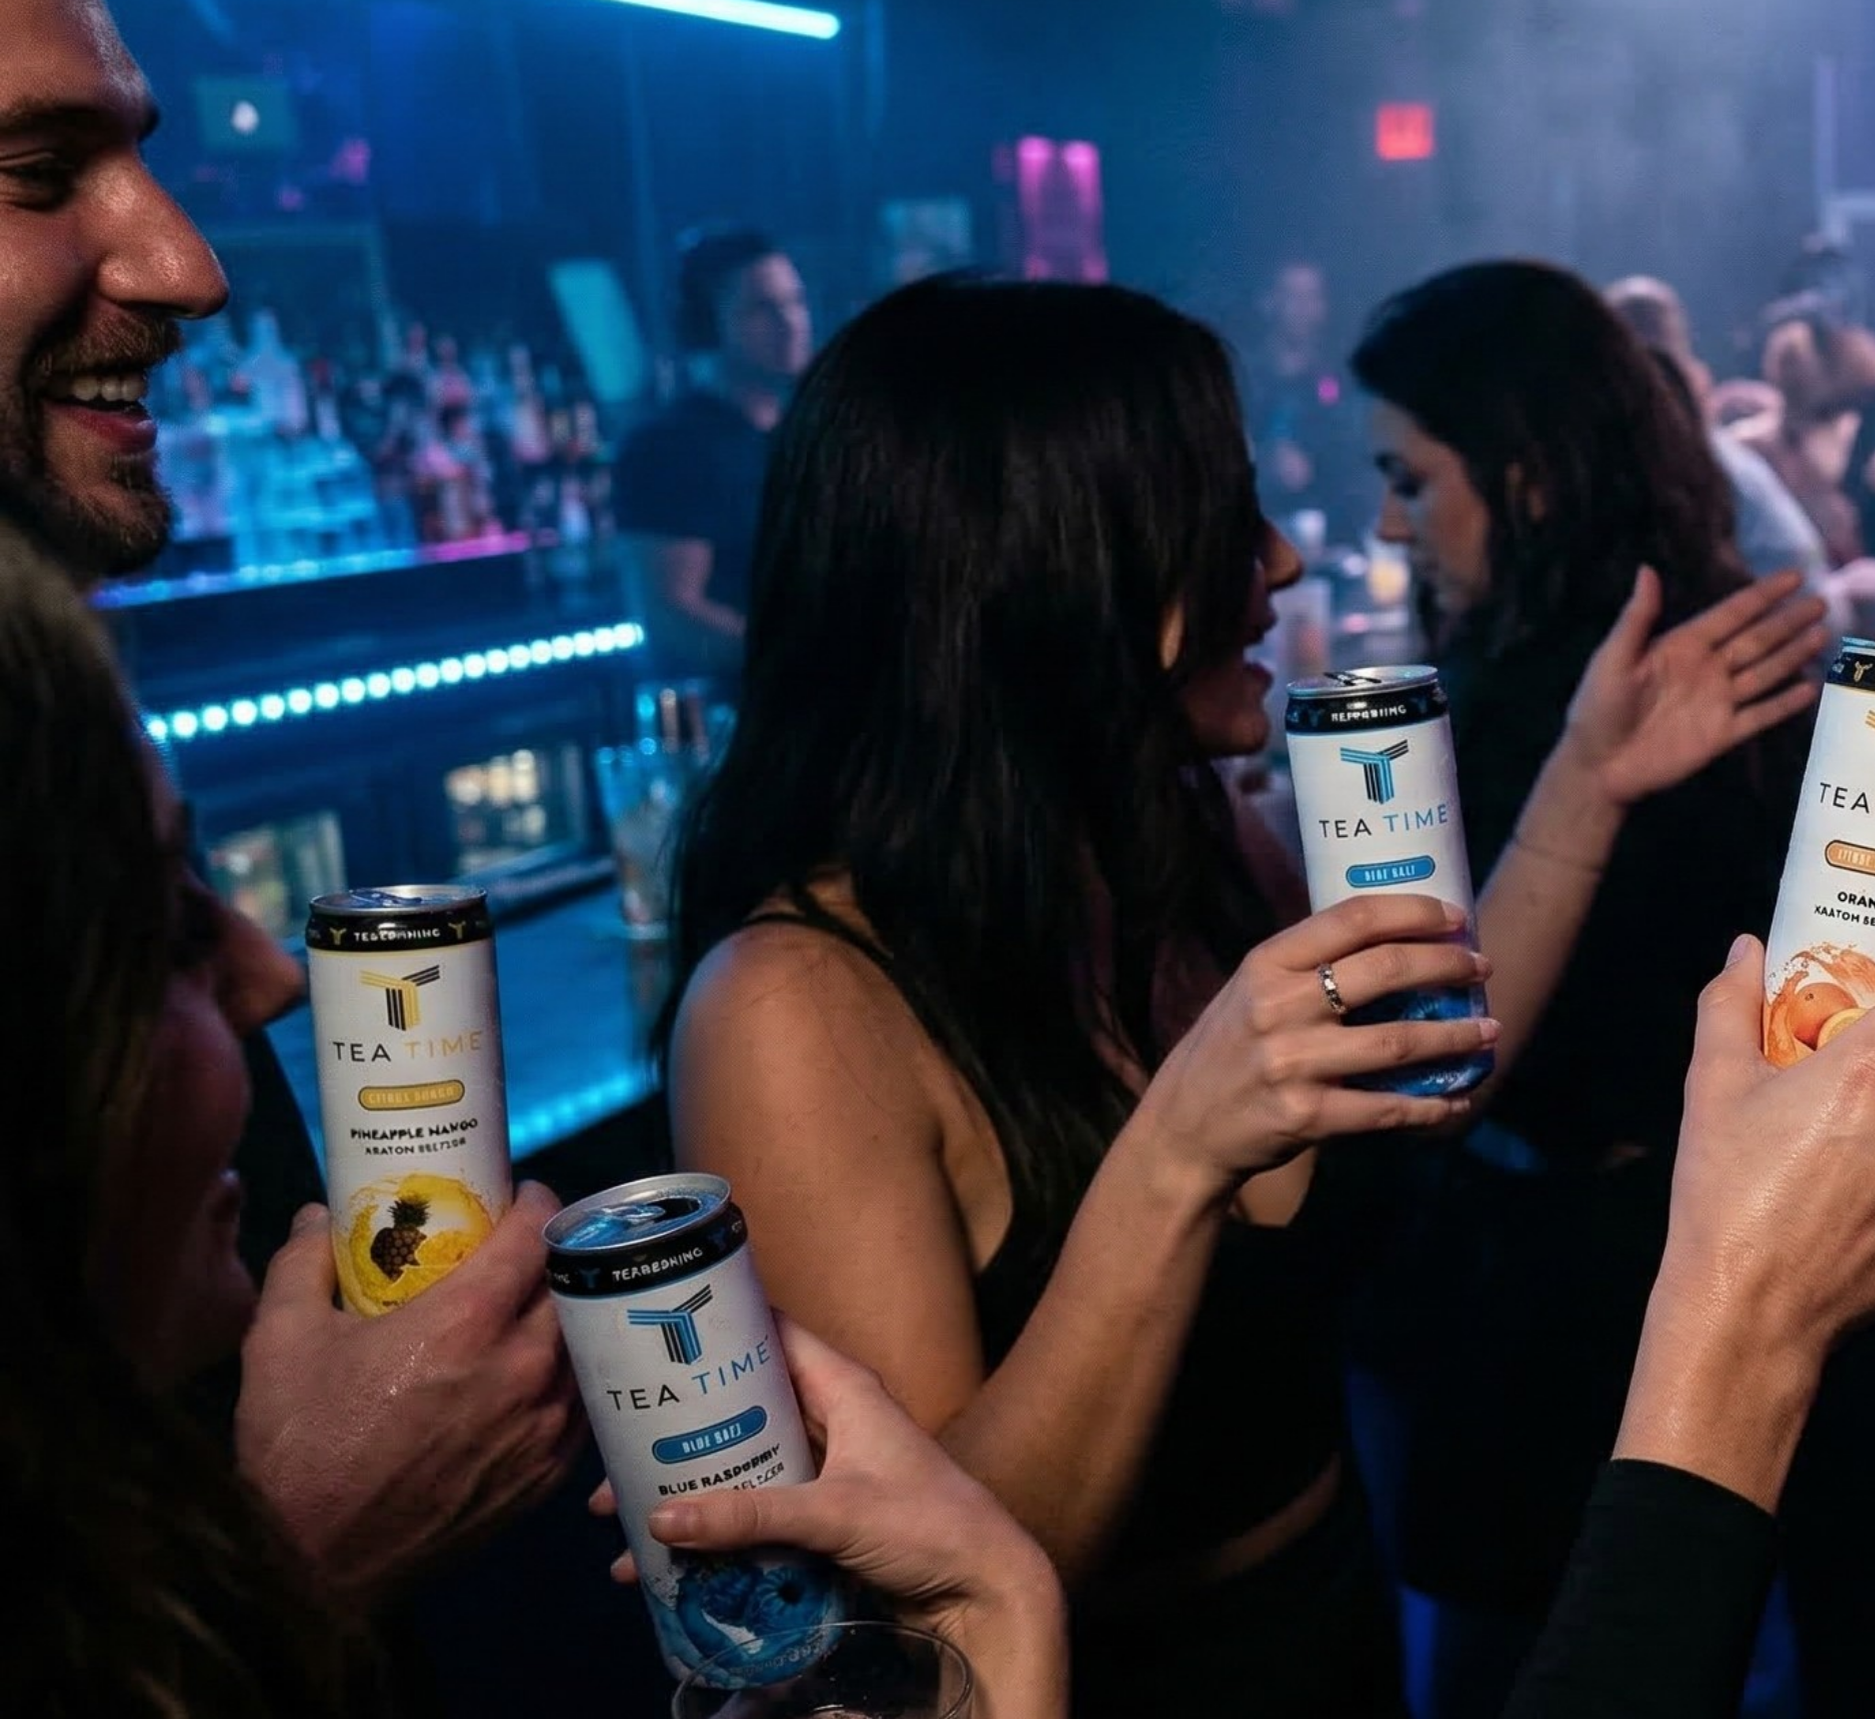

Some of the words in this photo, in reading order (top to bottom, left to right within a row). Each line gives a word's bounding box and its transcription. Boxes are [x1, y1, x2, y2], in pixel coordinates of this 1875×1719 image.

[1819, 782, 1870, 814] TEA
[1318, 818, 1372, 838] TEA
[1382, 803, 1448, 832] TIME
[333, 1041, 391, 1062] TEA
[403, 1030, 482, 1059] TIME
[607, 1384, 680, 1411] TEA
[691, 1341, 771, 1395] TIME
[658, 1480, 698, 1496] BLUE
